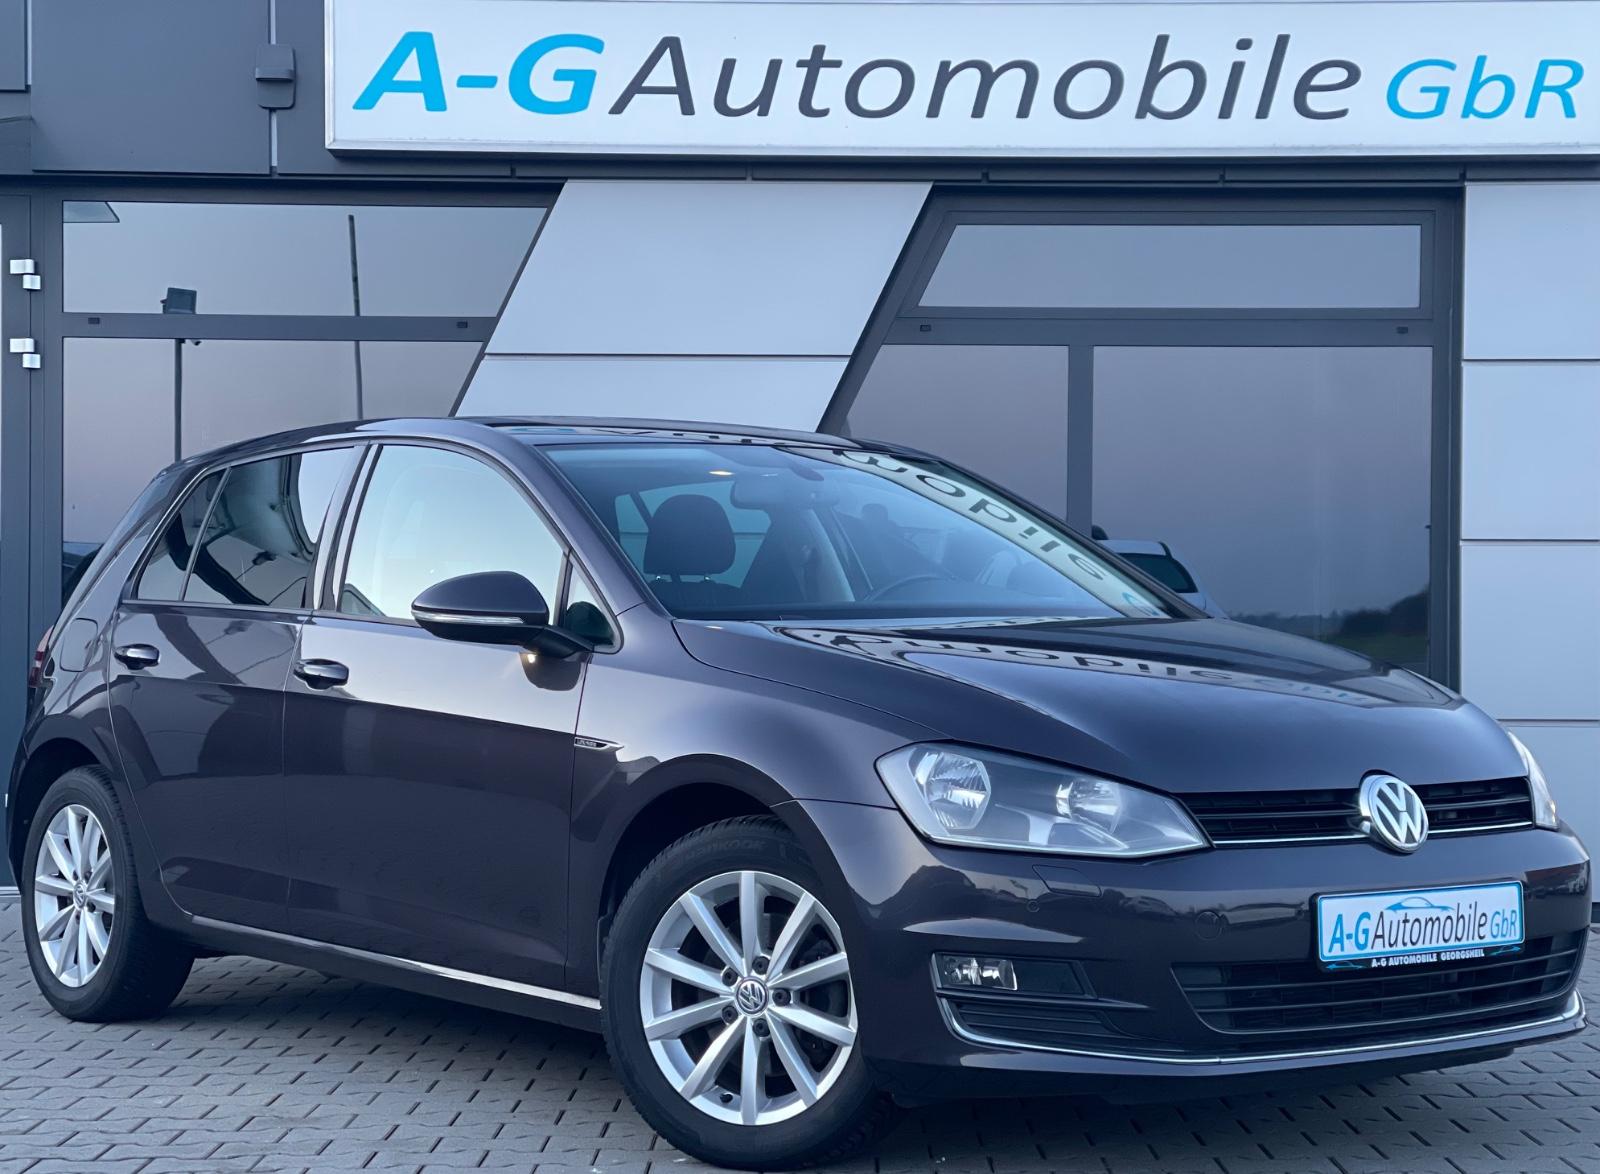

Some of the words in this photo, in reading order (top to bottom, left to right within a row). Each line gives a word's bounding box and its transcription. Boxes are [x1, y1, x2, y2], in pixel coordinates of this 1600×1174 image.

[352, 31, 605, 115] A-G
[607, 34, 1362, 121] Automobile
[1385, 55, 1585, 120] GbR
[1367, 777, 1427, 850] VW
[1328, 911, 1372, 953] A-G
[1371, 901, 1488, 949] Automobile
[1490, 909, 1518, 939] GbR
[1371, 957, 1387, 968] A-G
[1388, 954, 1438, 966] AUTOMOBILE
[738, 980, 766, 1012] VW
